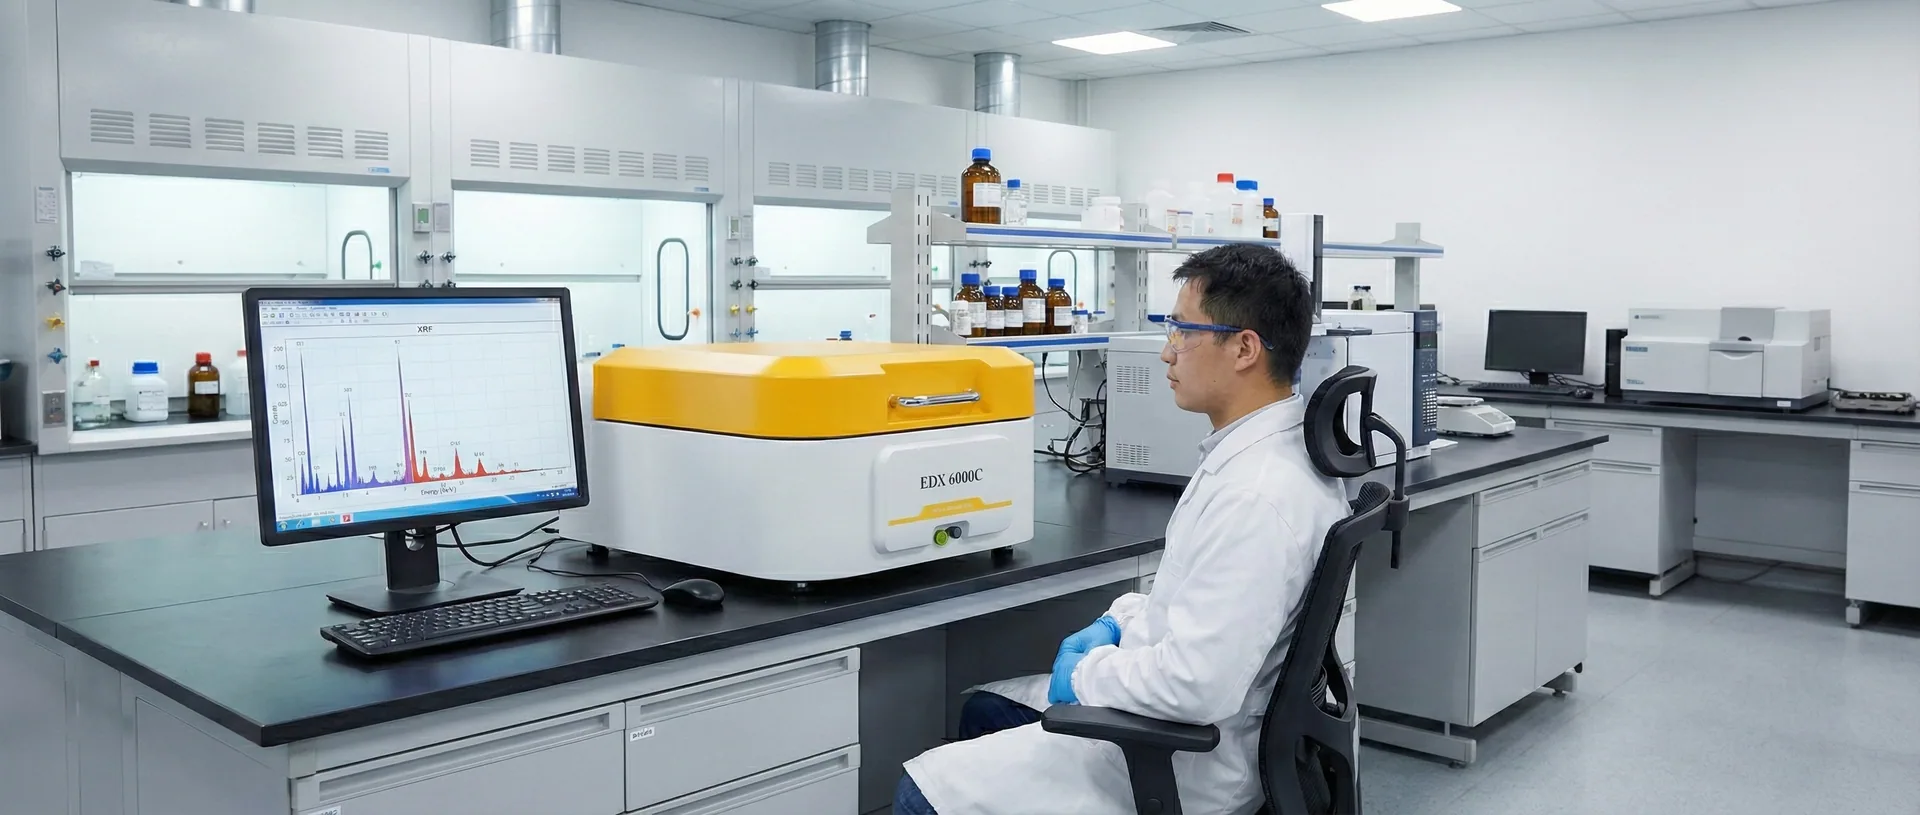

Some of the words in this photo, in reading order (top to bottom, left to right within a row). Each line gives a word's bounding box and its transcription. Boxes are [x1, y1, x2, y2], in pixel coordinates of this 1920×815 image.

[417, 325, 433, 333] XRF
[920, 473, 946, 490] EDX
[948, 467, 984, 486] 6000C
